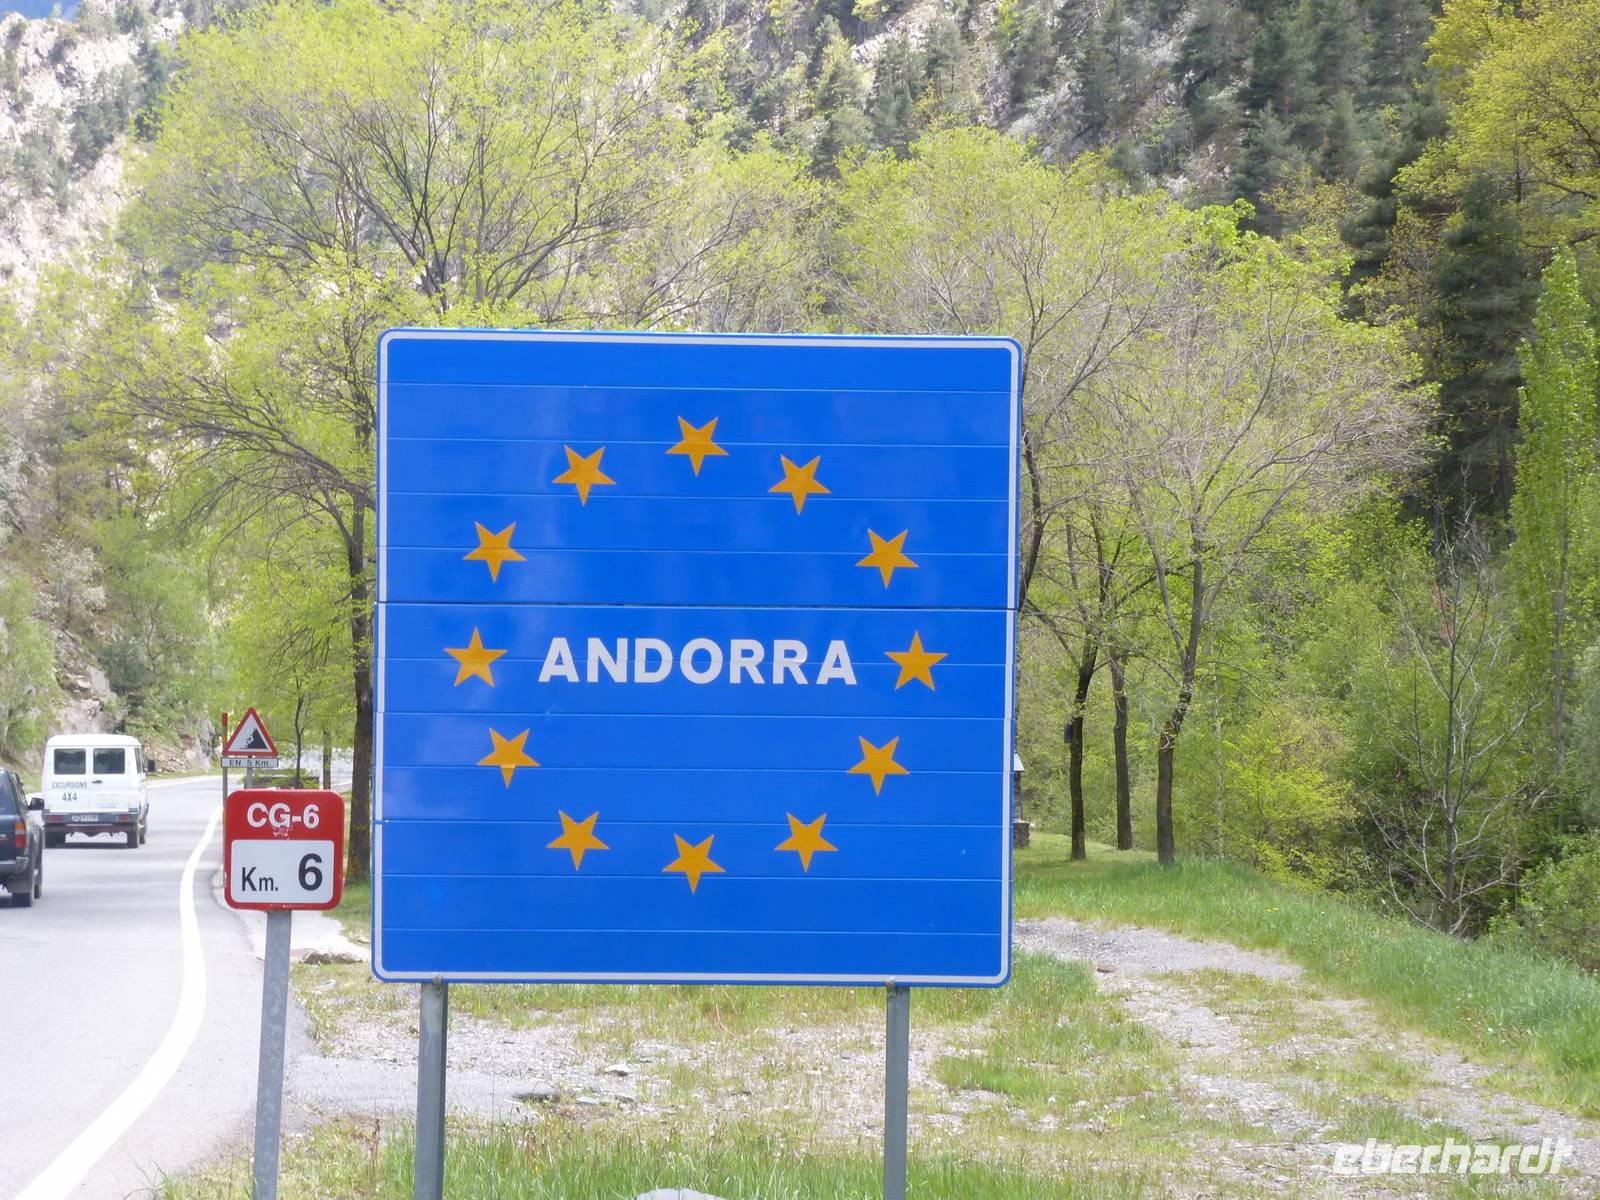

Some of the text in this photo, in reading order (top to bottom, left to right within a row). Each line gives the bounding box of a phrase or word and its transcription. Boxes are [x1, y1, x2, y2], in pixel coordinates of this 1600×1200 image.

[538, 637, 857, 685] ANDORRA
[229, 759, 241, 767] EN
[52, 782, 88, 790] EXCURSIONS
[62, 792, 78, 802] 4X4
[247, 802, 320, 829] CG-6
[241, 853, 323, 892] Km. 6
